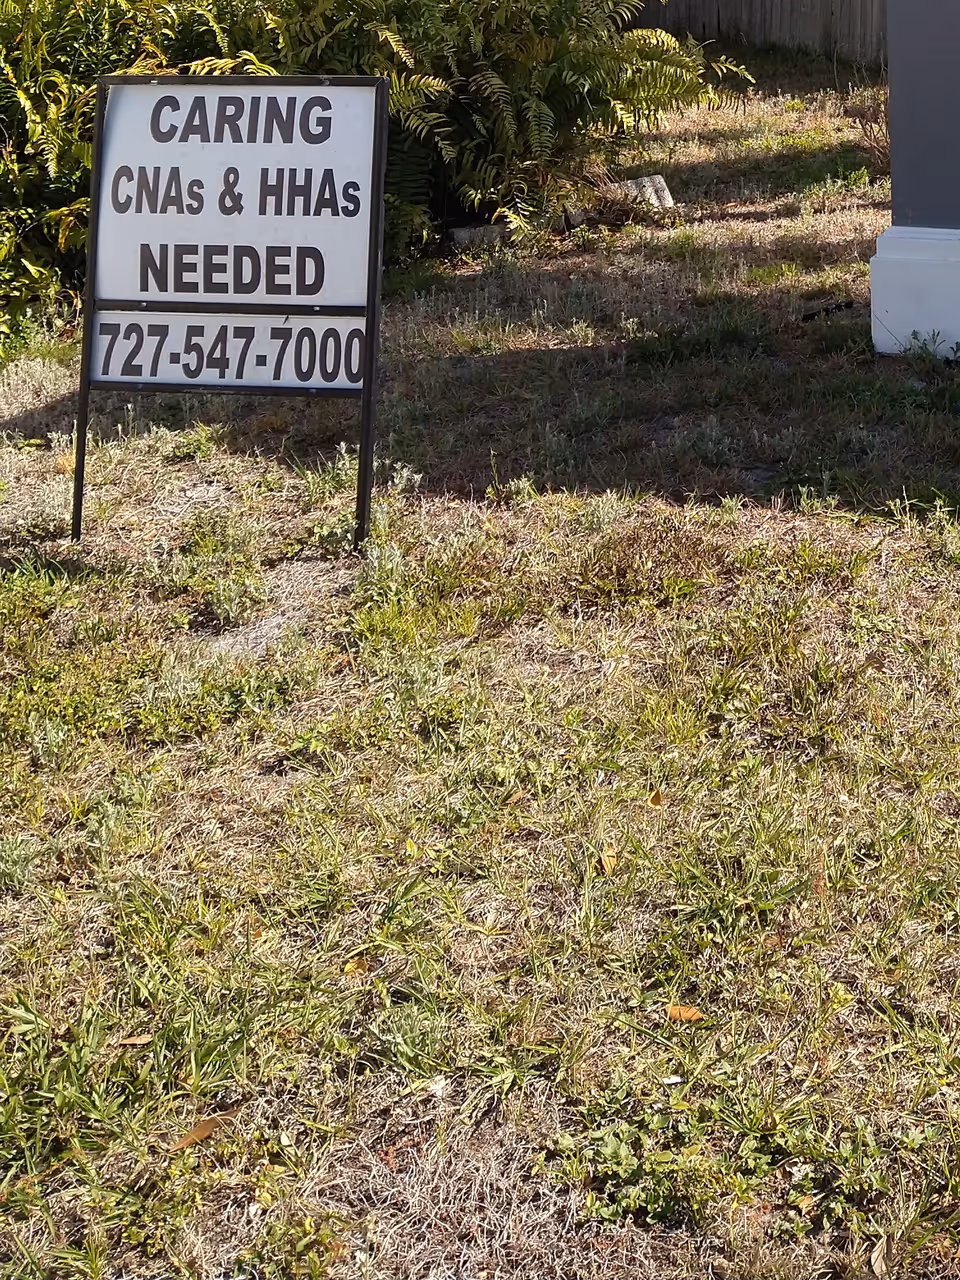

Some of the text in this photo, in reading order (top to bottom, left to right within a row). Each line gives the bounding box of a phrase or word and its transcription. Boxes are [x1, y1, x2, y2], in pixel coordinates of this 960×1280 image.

[151, 96, 333, 144] CARING
[111, 165, 361, 217] CNAs & HHAs
[140, 244, 325, 296] NEEDED
[98, 323, 366, 384] 727-547-7000
